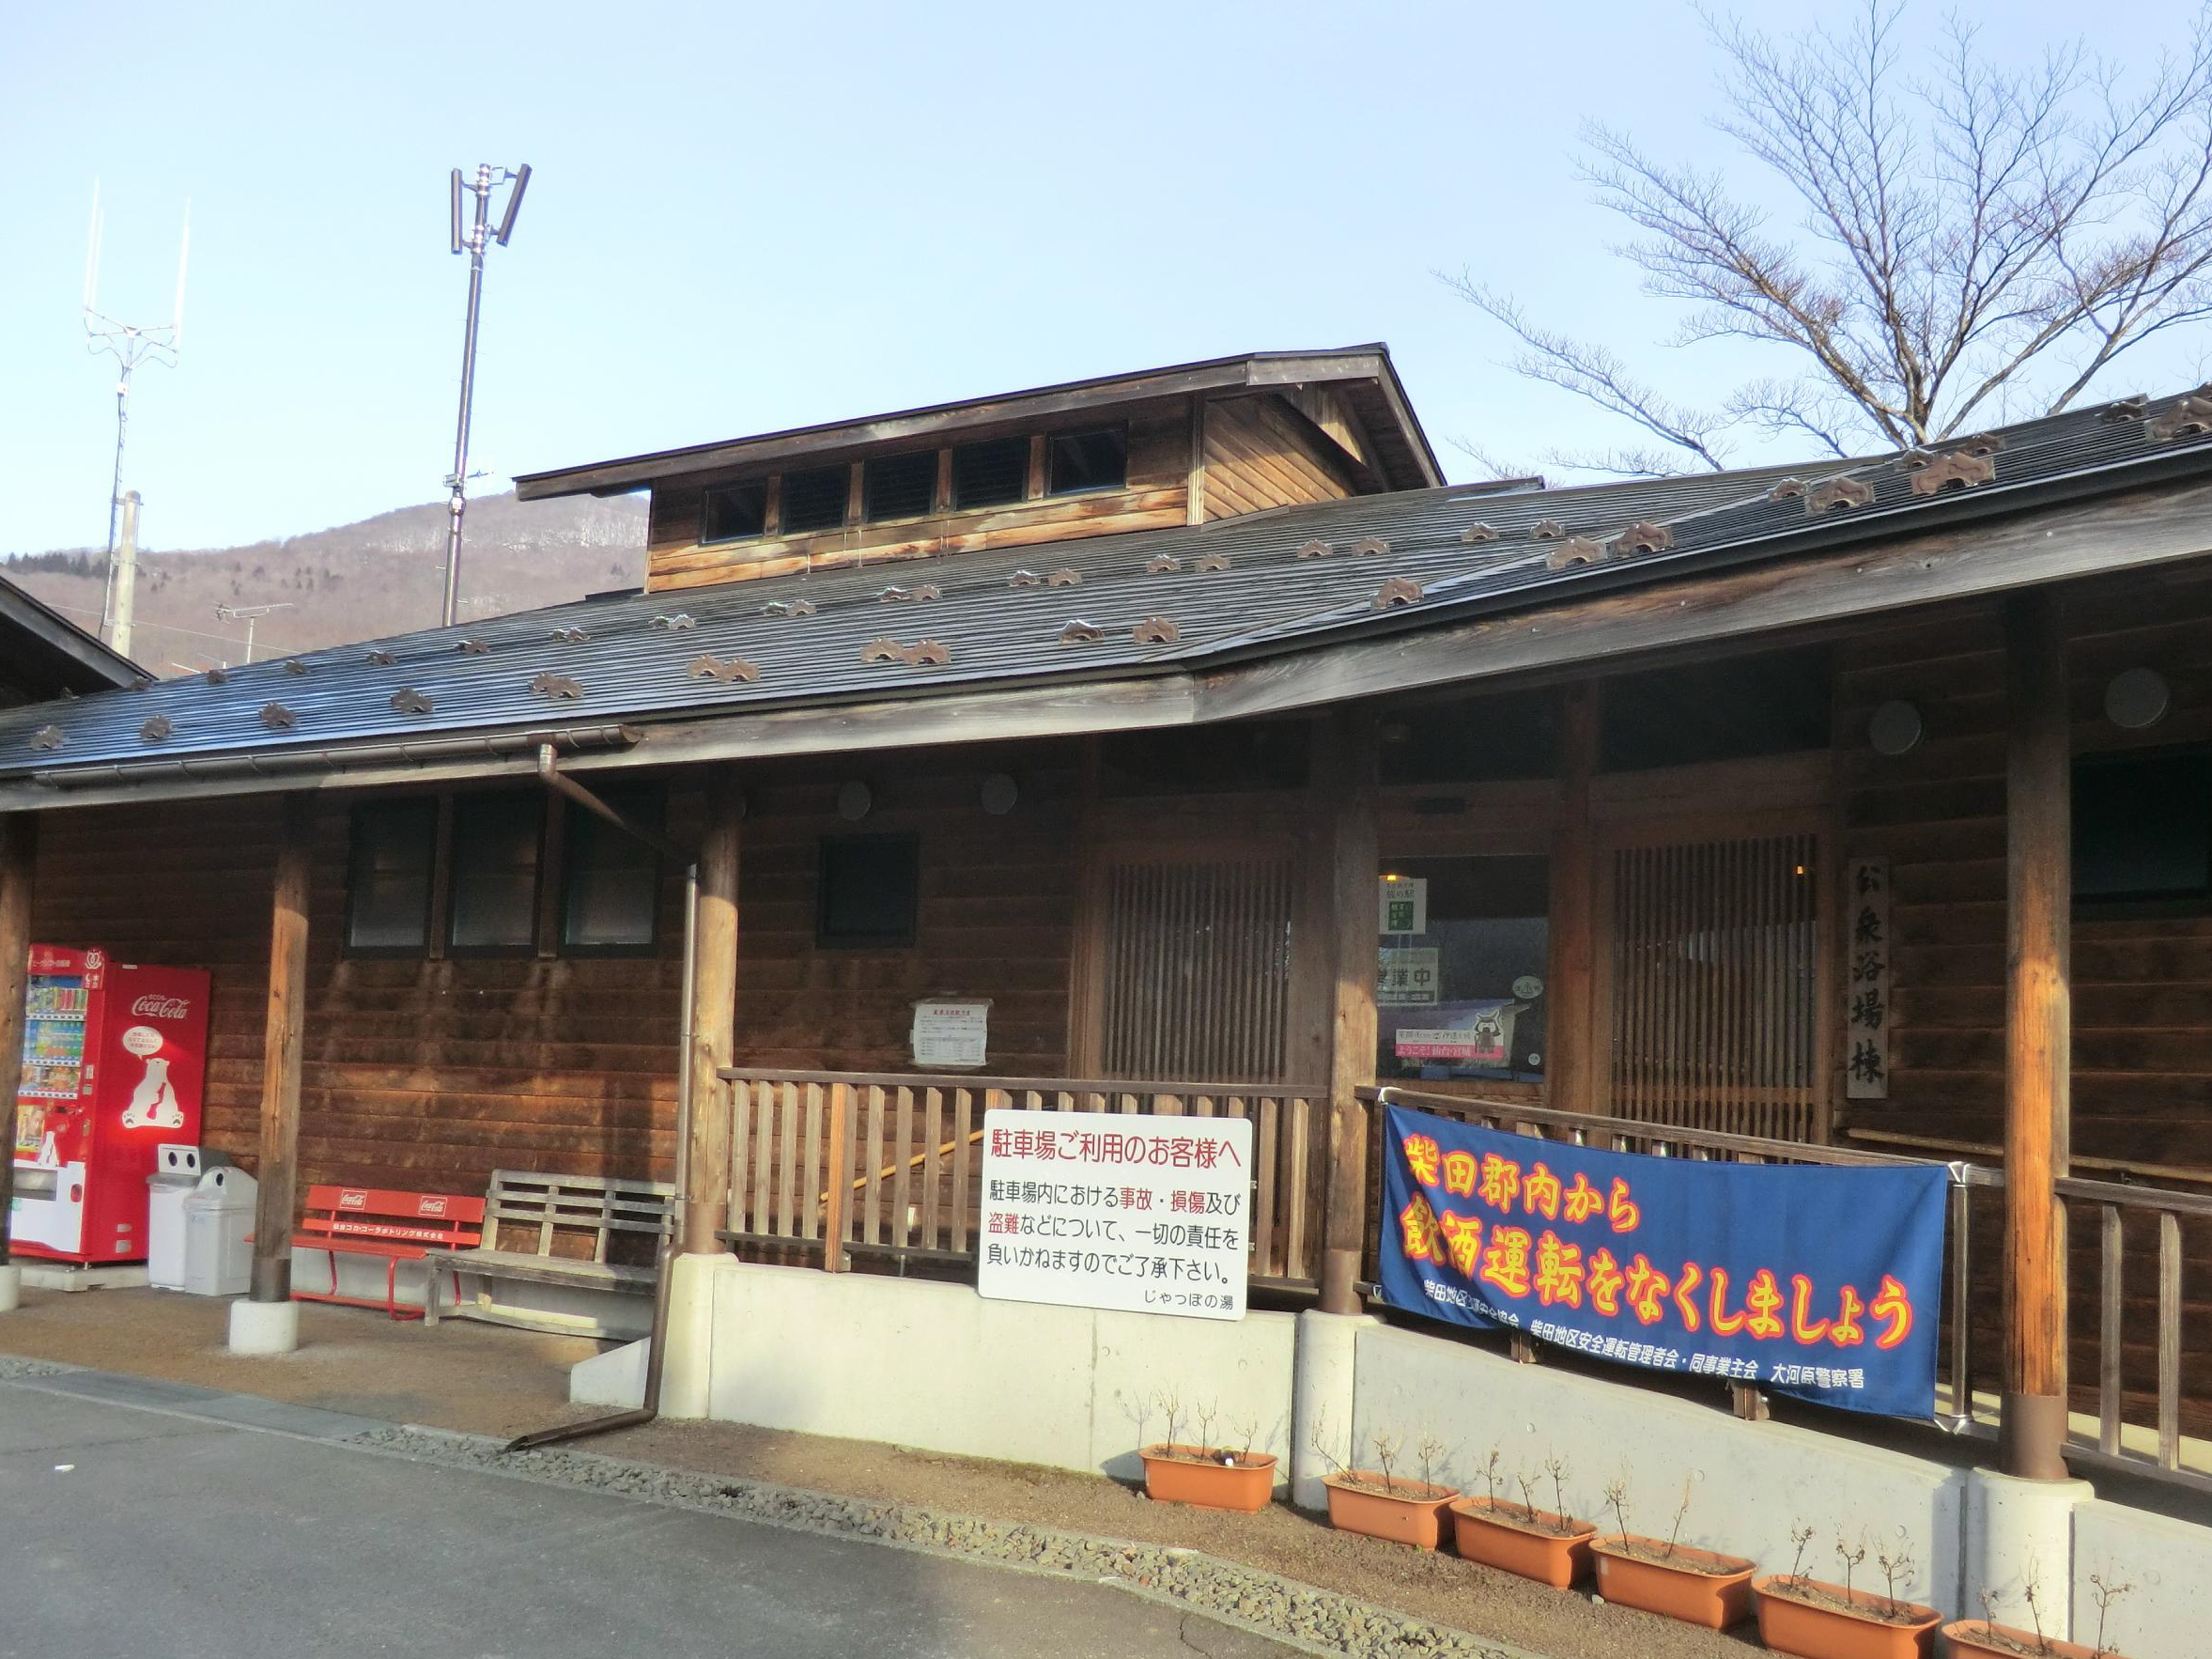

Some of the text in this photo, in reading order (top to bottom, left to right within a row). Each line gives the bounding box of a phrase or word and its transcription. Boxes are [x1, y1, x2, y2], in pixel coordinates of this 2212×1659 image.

[991, 1128, 1242, 1169] 駐車場ご利用のお客様へ
[989, 1179, 1242, 1216] 駐車場内における事故・損傷及び
[1403, 1133, 1641, 1233] 柴田郡内から
[988, 1213, 1239, 1249] 盗難などについて、一切の責任を
[986, 1243, 1229, 1284] 負いかねますのでご了承下さい。
[1400, 1193, 1913, 1350] 飲酒運転をなくしましょう
[1144, 1289, 1234, 1310] じゃっぽの湯
[1771, 1362, 1864, 1388] 大河原警察署
